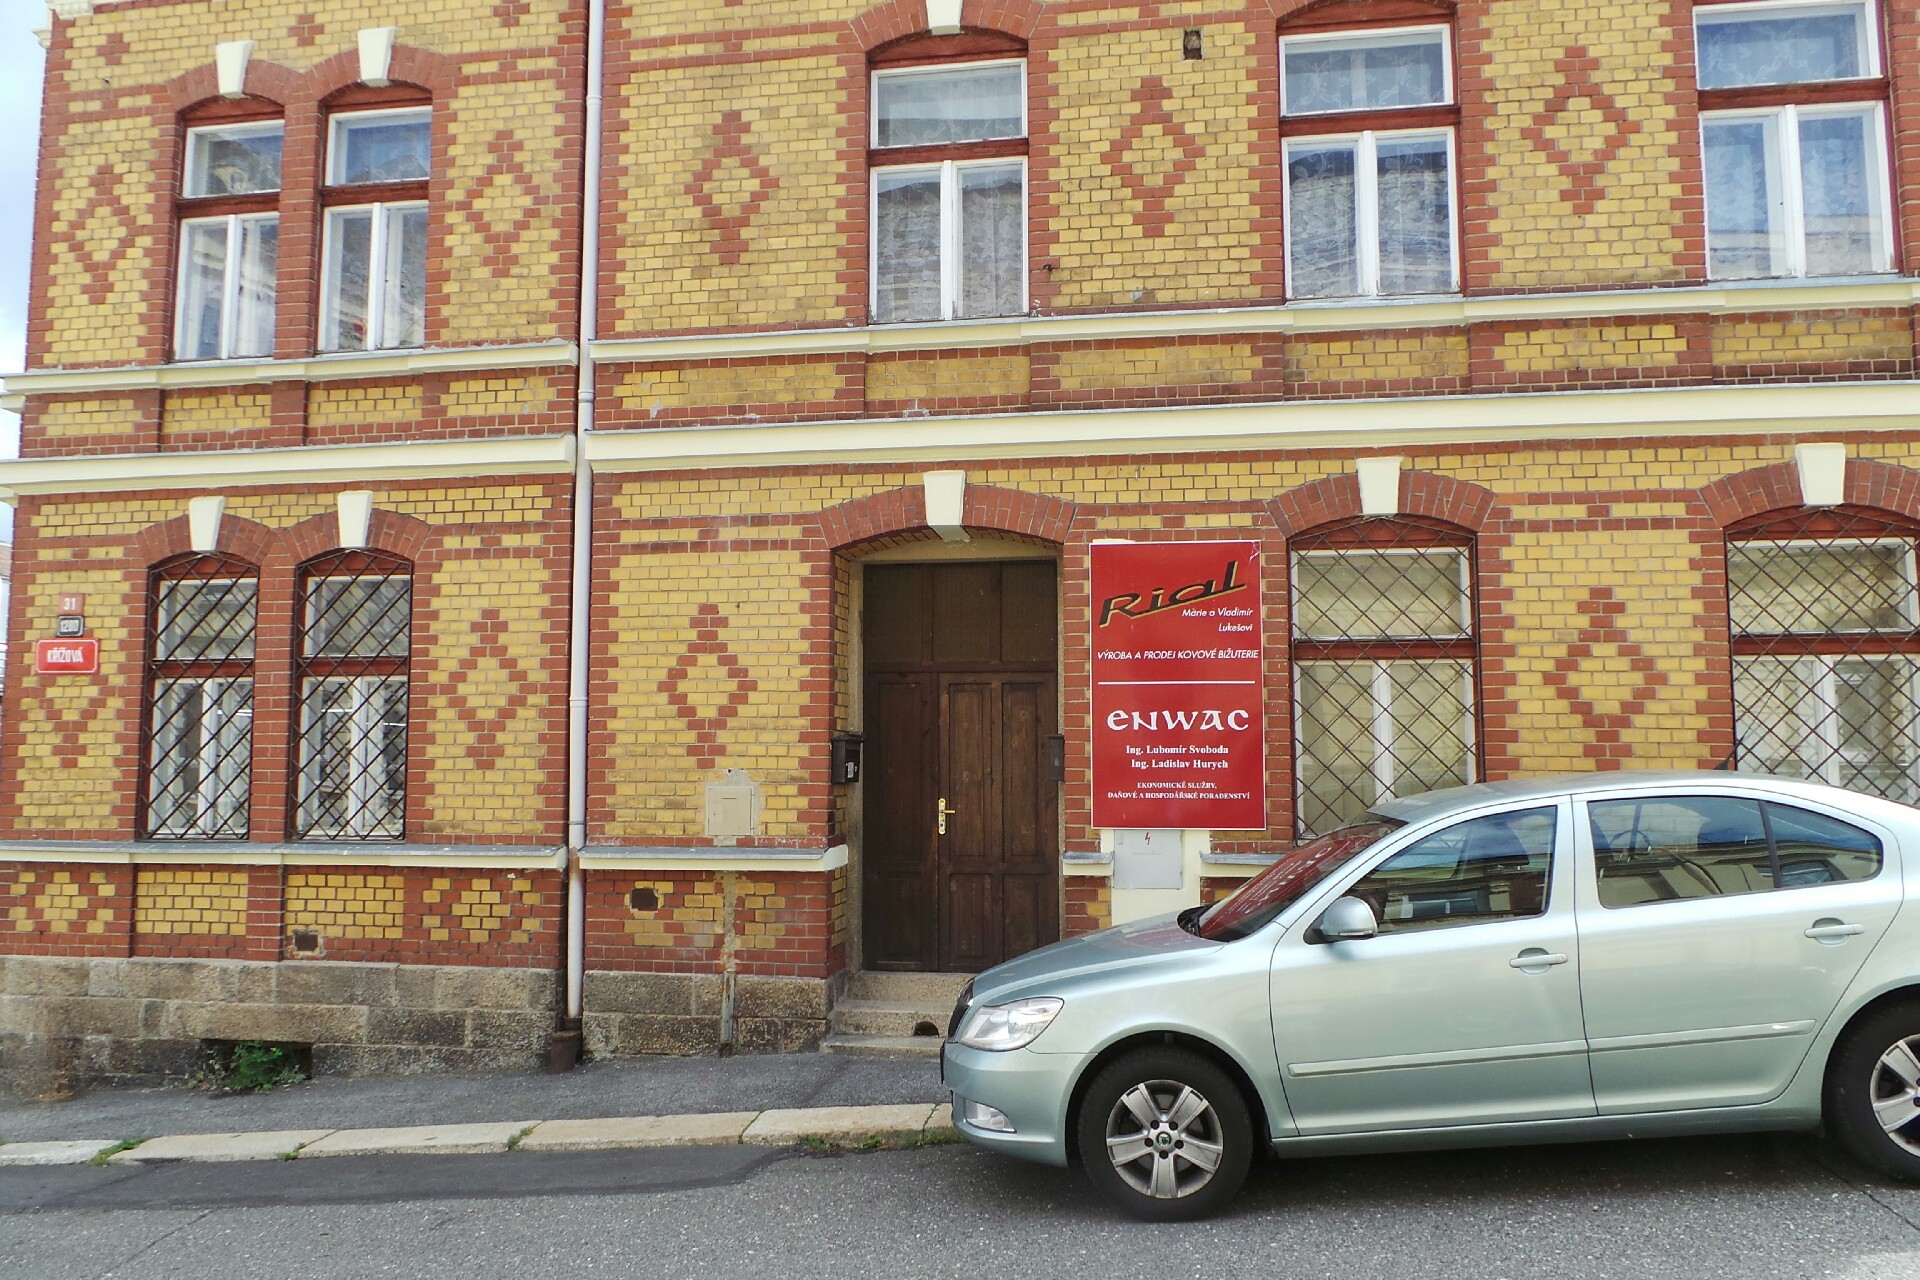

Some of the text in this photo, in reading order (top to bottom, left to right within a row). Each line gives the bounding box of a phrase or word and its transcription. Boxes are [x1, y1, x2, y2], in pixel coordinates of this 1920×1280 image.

[1099, 560, 1247, 628] Rial
[64, 598, 76, 610] 31
[1181, 609, 1207, 617] Marie
[1217, 607, 1253, 617] Vladimír
[47, 646, 84, 663] KŘÍŽOVÁ
[1097, 648, 1259, 660] VÝROBA A PRODEJ KOVOVÉ BIŽUTERIE
[1126, 744, 1229, 756] Ing. Lubomír Svoboda
[1131, 759, 1229, 770] Ing. Ladislav Hurych
[1137, 781, 1217, 790] EKONOMICKÉ SLUŽBY,
[1108, 790, 1138, 799] DAŇOVÉ
[1145, 790, 1198, 799] HOSPODÁŘSKÉ
[1199, 791, 1250, 800] PORADENSTVÍ
